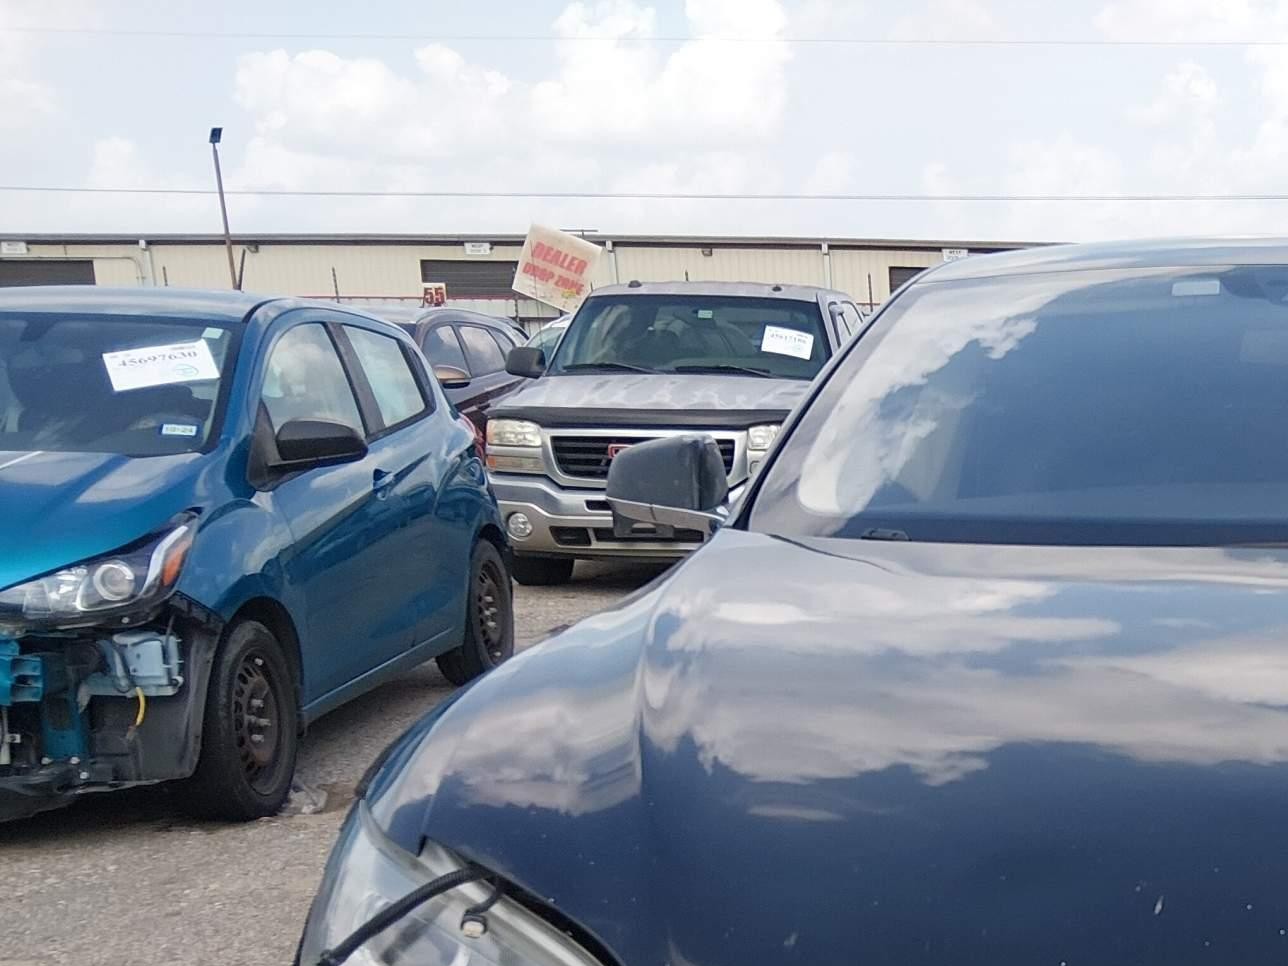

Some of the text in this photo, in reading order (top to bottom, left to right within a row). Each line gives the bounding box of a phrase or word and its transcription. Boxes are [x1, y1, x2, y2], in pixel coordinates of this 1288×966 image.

[532, 241, 588, 275] DEALER
[523, 262, 585, 297] DROP ZONE
[424, 286, 445, 305] 55
[118, 351, 198, 368] 45697630
